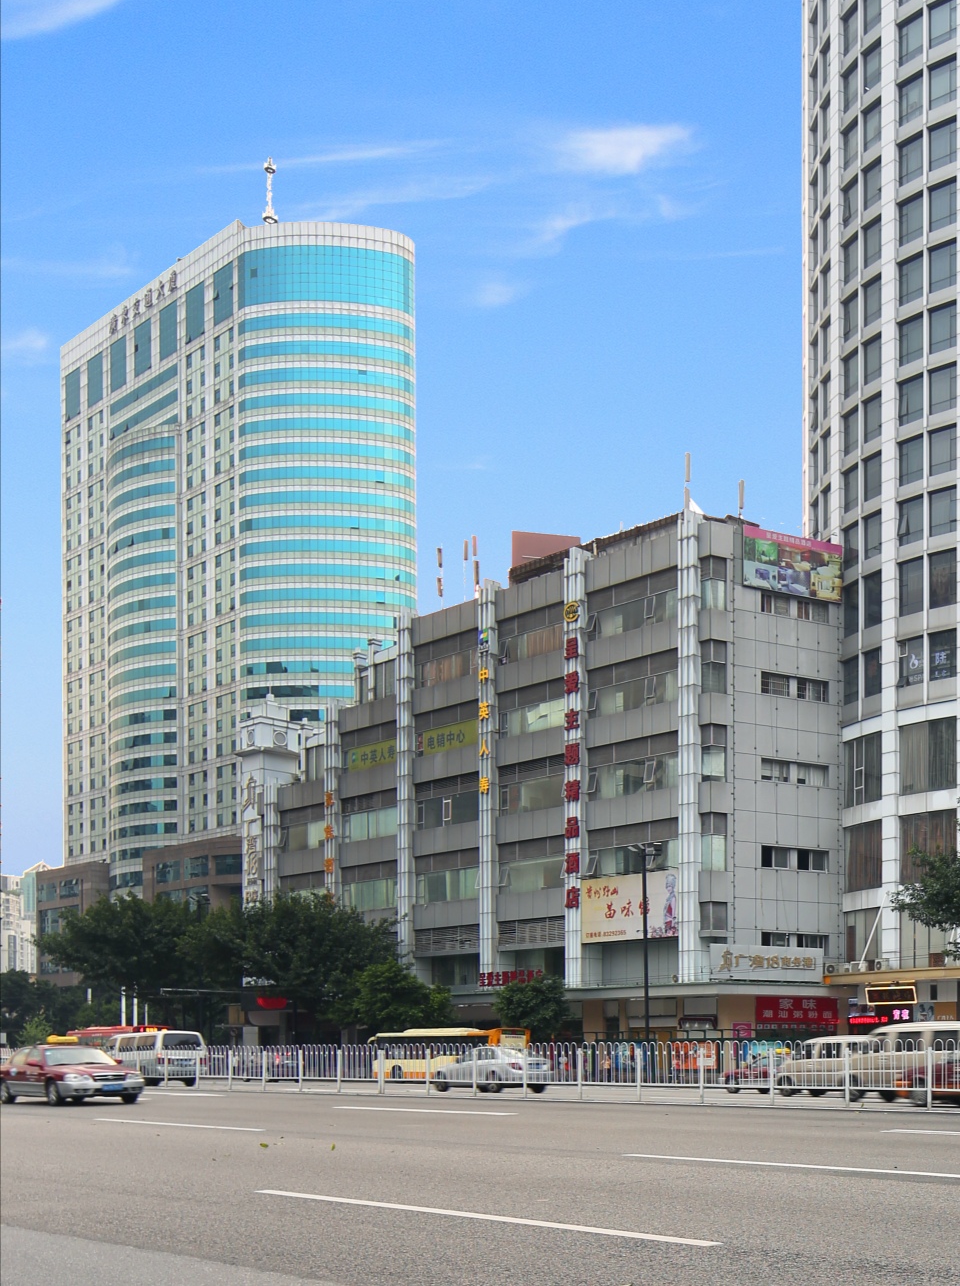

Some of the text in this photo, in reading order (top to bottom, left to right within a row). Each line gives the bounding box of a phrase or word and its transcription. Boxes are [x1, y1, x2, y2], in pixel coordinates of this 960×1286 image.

[427, 730, 465, 750] 电销中心
[478, 667, 490, 795] 中英人寿
[360, 745, 396, 766] 中英人寿
[564, 637, 580, 910] 呈爱主题精品酒店
[779, 999, 817, 1009] 家味
[763, 1010, 832, 1019] 潮汕粥粉面
